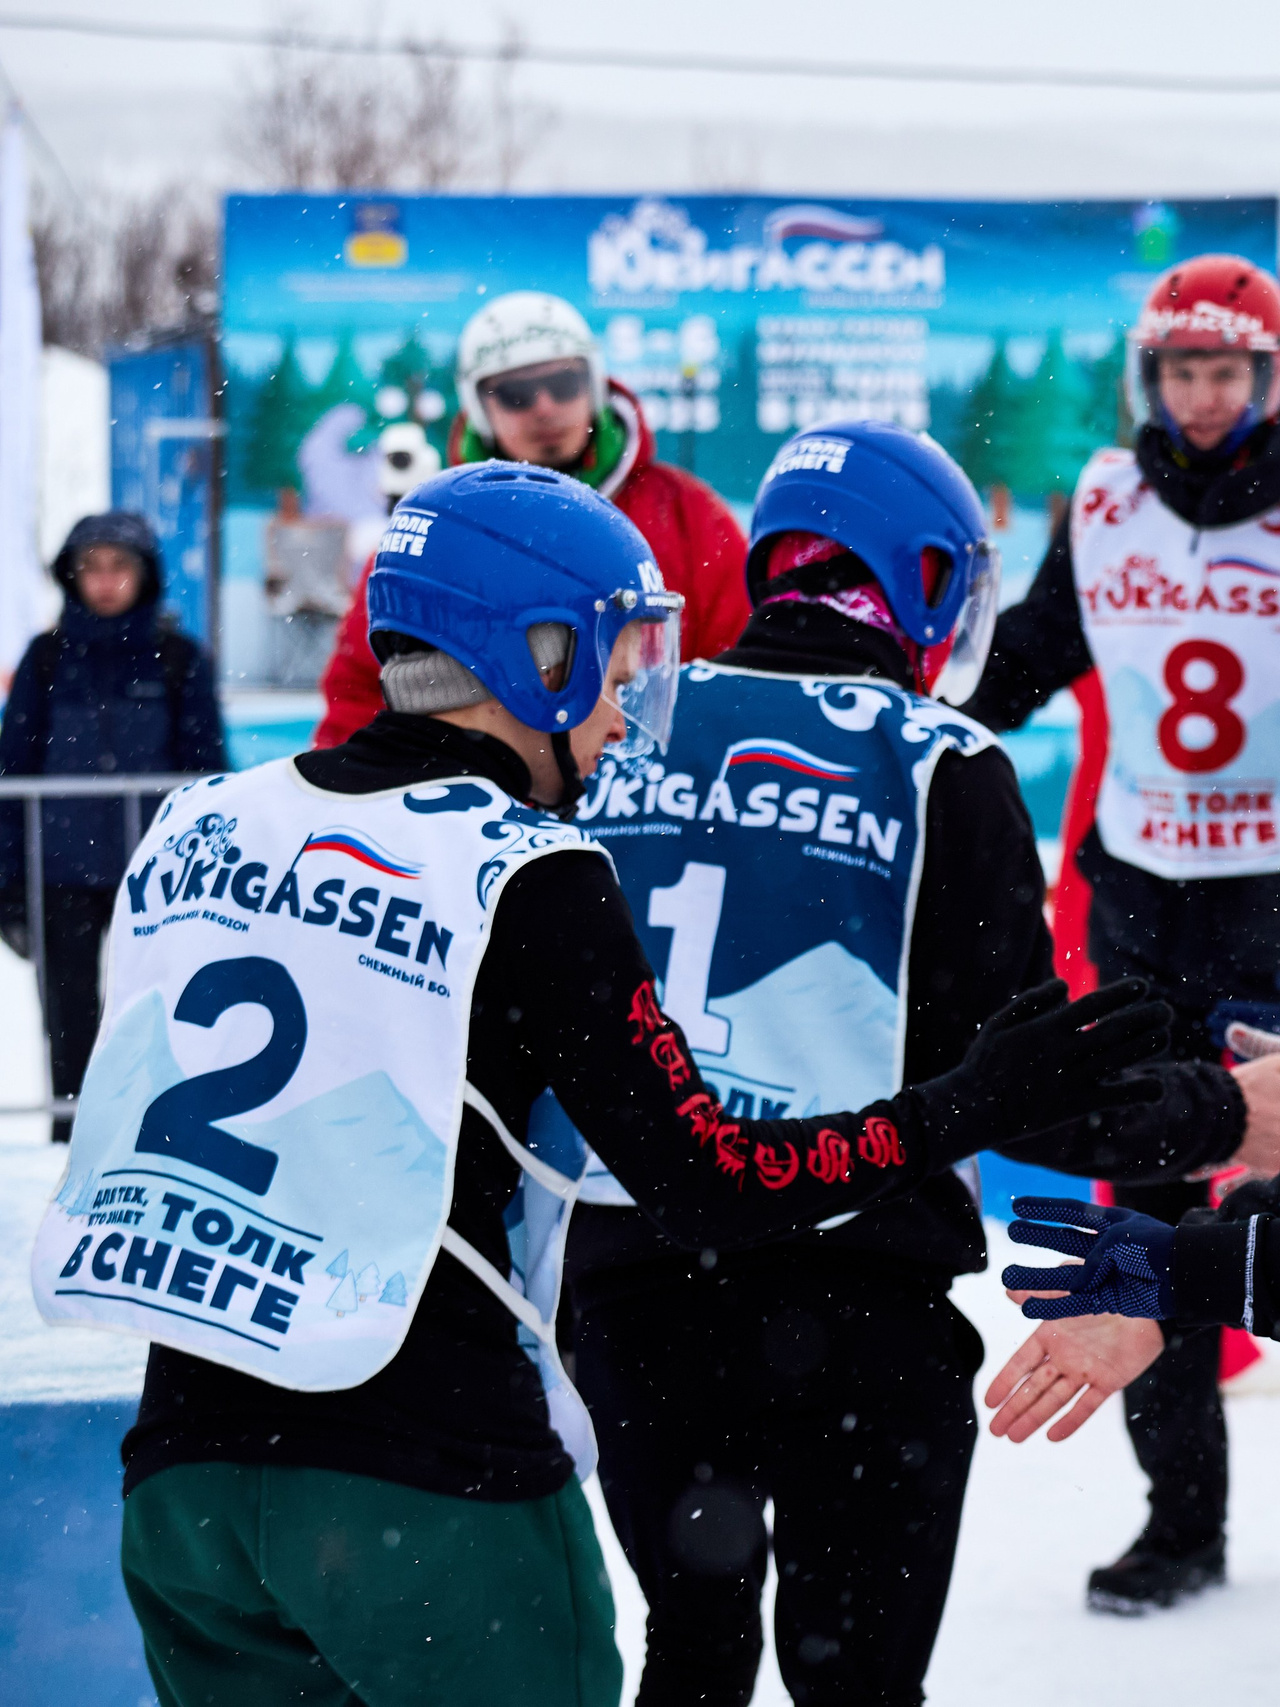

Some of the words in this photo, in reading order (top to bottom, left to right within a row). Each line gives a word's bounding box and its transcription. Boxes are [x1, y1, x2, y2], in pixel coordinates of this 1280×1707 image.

[378, 531, 427, 557] НЕГЕ
[1157, 639, 1246, 774] 8
[201, 909, 251, 933] REGION
[647, 861, 732, 1056] 1
[357, 953, 425, 990] СНЕЖНЫЙ
[134, 955, 308, 1197] 2
[59, 1233, 93, 1279] В
[91, 1231, 301, 1335] СНЕГЕ
[161, 1191, 317, 1286] ТОЛК
